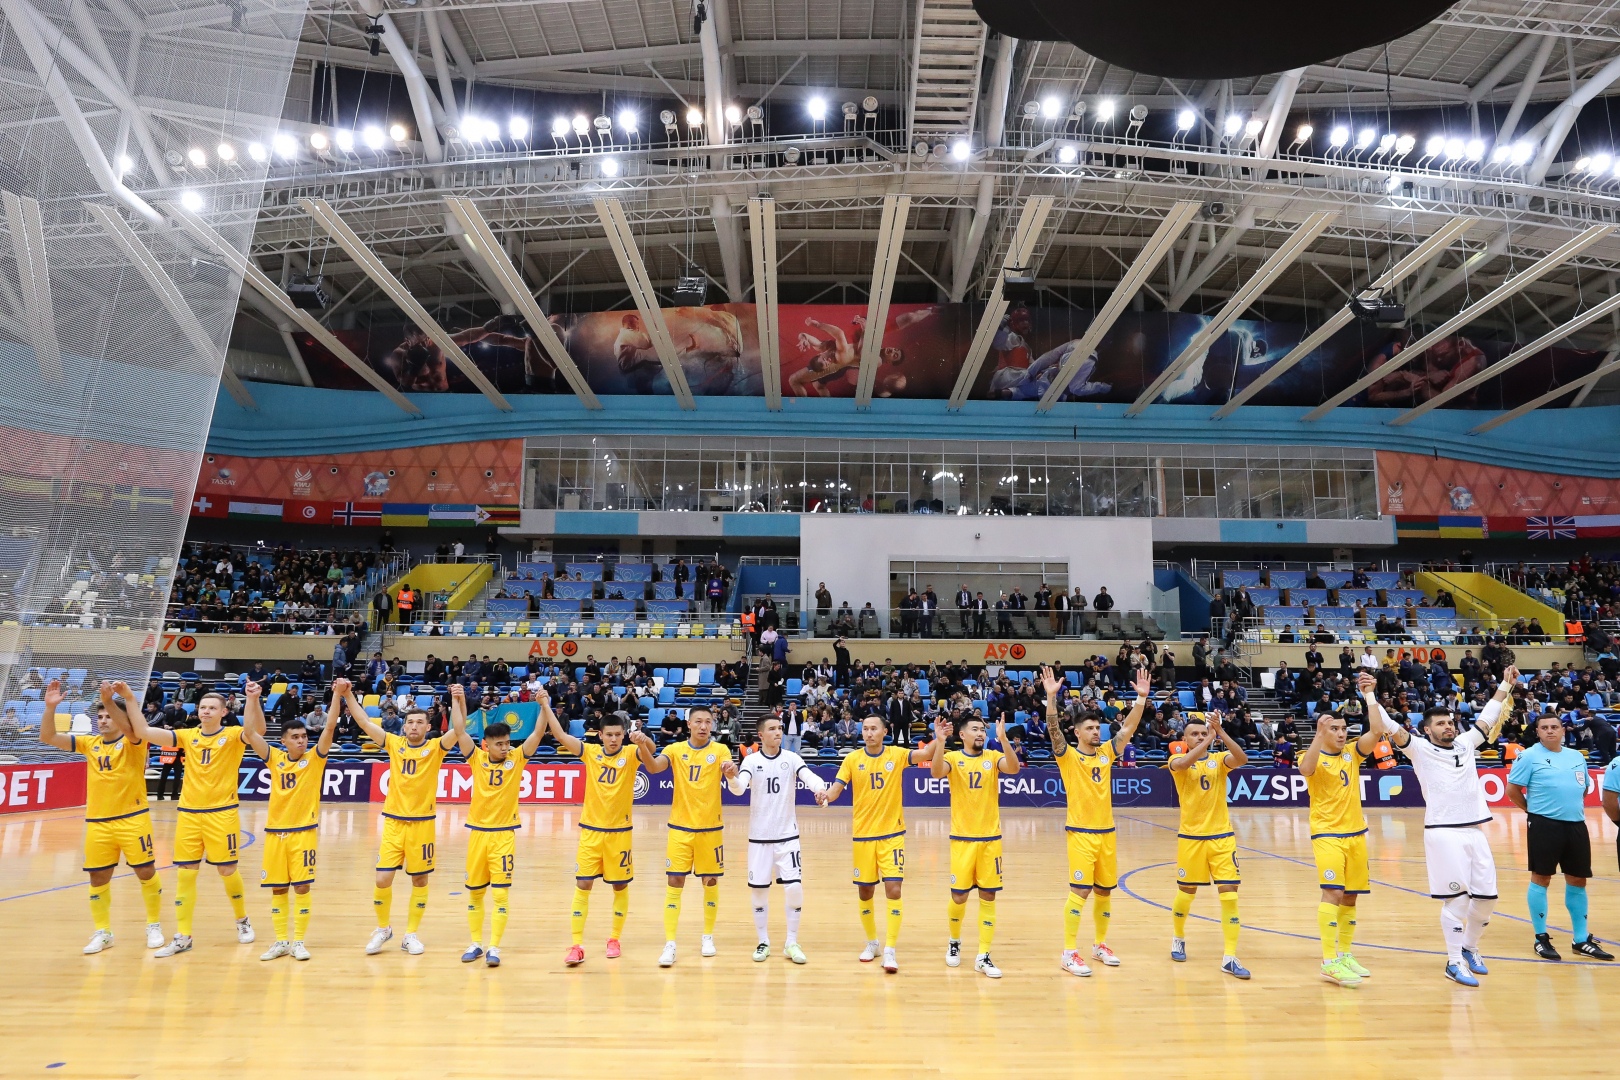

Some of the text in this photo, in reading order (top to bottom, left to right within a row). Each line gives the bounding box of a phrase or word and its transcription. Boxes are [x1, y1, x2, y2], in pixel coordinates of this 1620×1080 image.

[211, 478, 237, 486] TASSAY
[97, 755, 112, 771] 14
[200, 748, 211, 765] 11
[401, 758, 417, 775] 10
[598, 766, 617, 784] 20
[688, 765, 702, 782] 17
[1091, 766, 1102, 783] 8
[280, 772, 297, 790] 18
[488, 769, 504, 786] 13
[766, 776, 781, 794] 16
[870, 772, 885, 790] 15
[968, 771, 983, 789] 12
[1200, 774, 1210, 791] 6
[1339, 769, 1349, 787] 9
[998, 777, 1042, 795] TSAL
[1044, 778, 1152, 797] QUIERS
[138, 833, 154, 853] 14
[226, 833, 237, 851] 11
[302, 849, 317, 868] 18
[421, 842, 434, 861] 10
[892, 848, 905, 867] 15
[501, 853, 514, 872] 13
